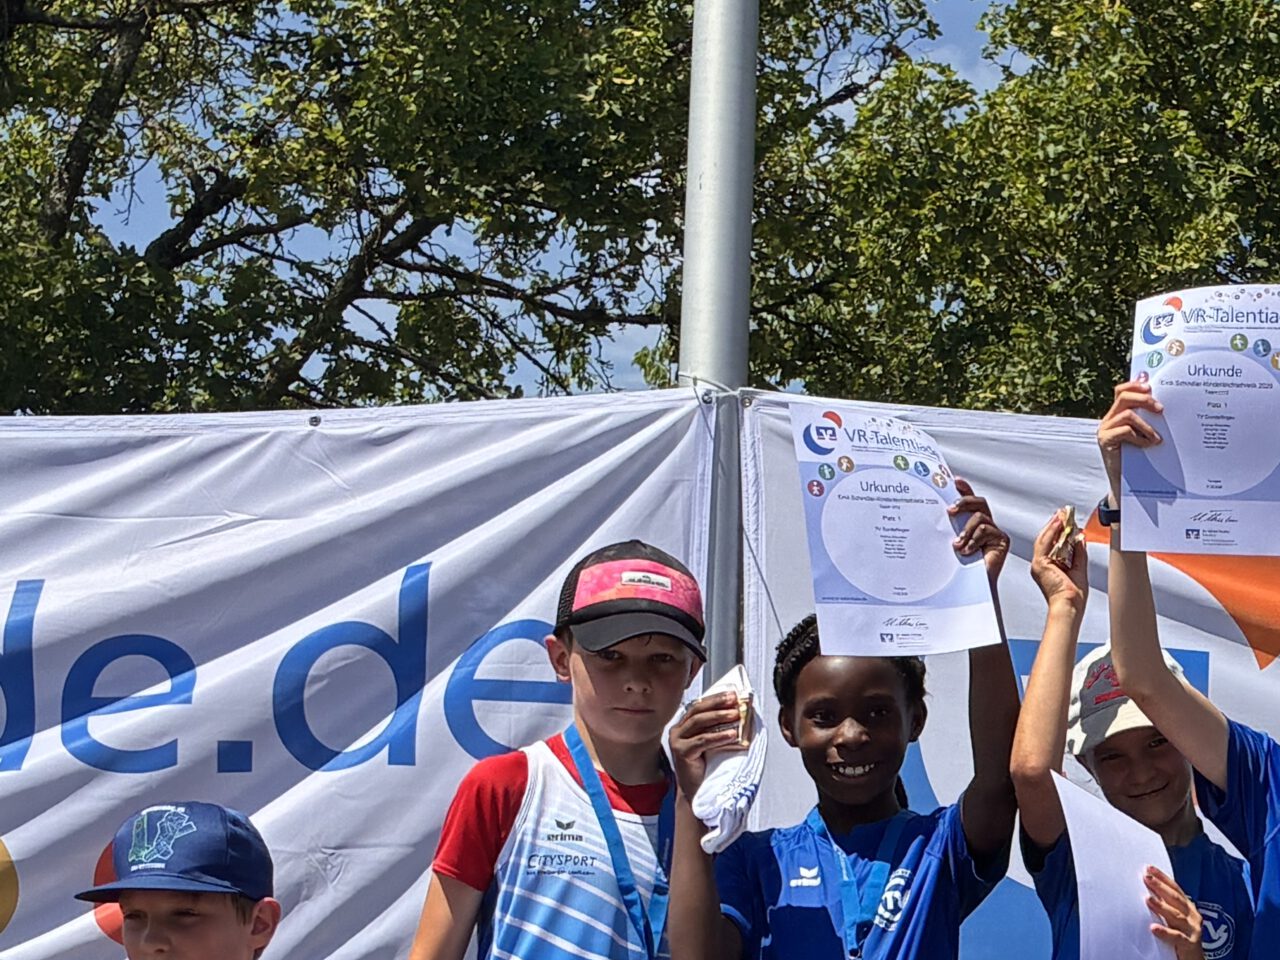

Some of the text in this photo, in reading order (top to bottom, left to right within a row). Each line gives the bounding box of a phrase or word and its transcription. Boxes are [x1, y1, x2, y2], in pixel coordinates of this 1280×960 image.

[1188, 364, 1243, 378] Urkunde
[860, 481, 910, 494] Urkunde
[547, 832, 584, 842] erima
